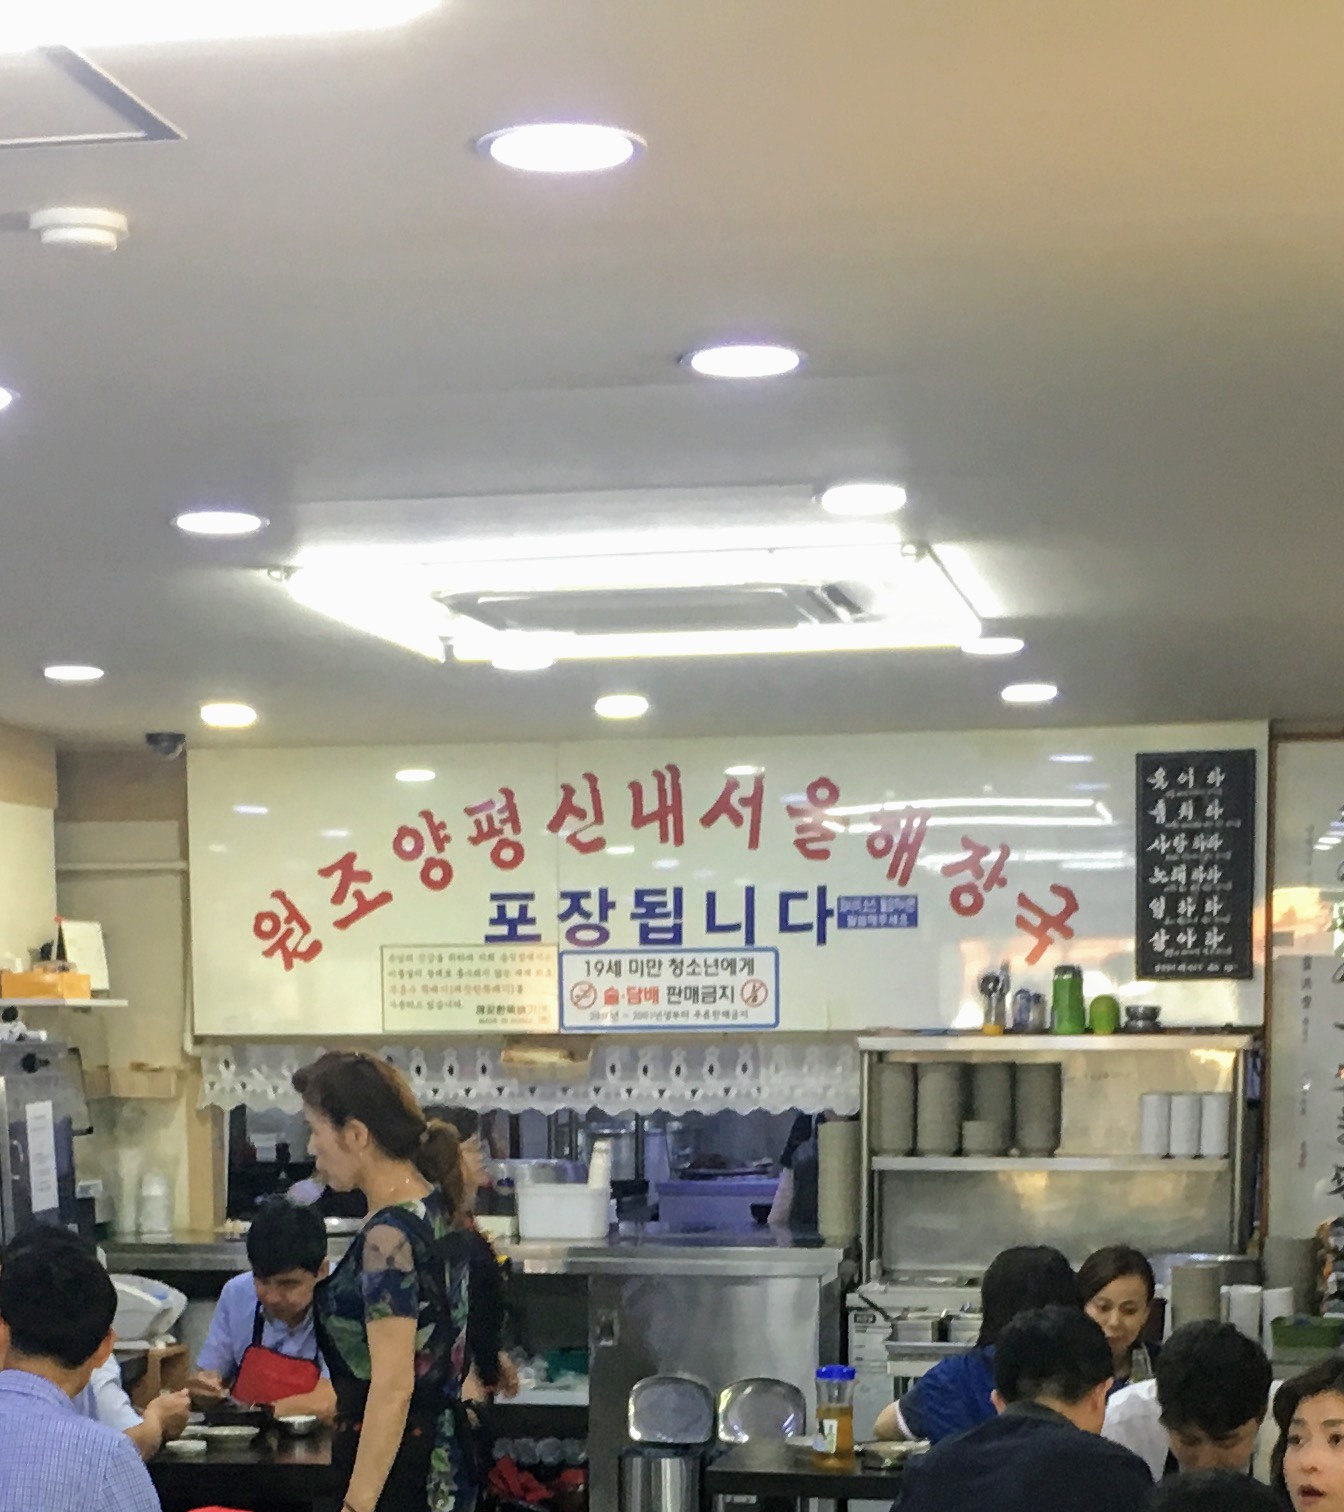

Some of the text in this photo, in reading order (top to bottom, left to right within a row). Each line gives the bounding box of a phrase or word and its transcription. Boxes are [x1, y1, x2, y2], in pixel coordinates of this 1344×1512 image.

[484, 884, 835, 948] 포장됩니다
[584, 957, 755, 977] 19세 미만 청소년에게
[666, 984, 735, 1004] 판매금지
